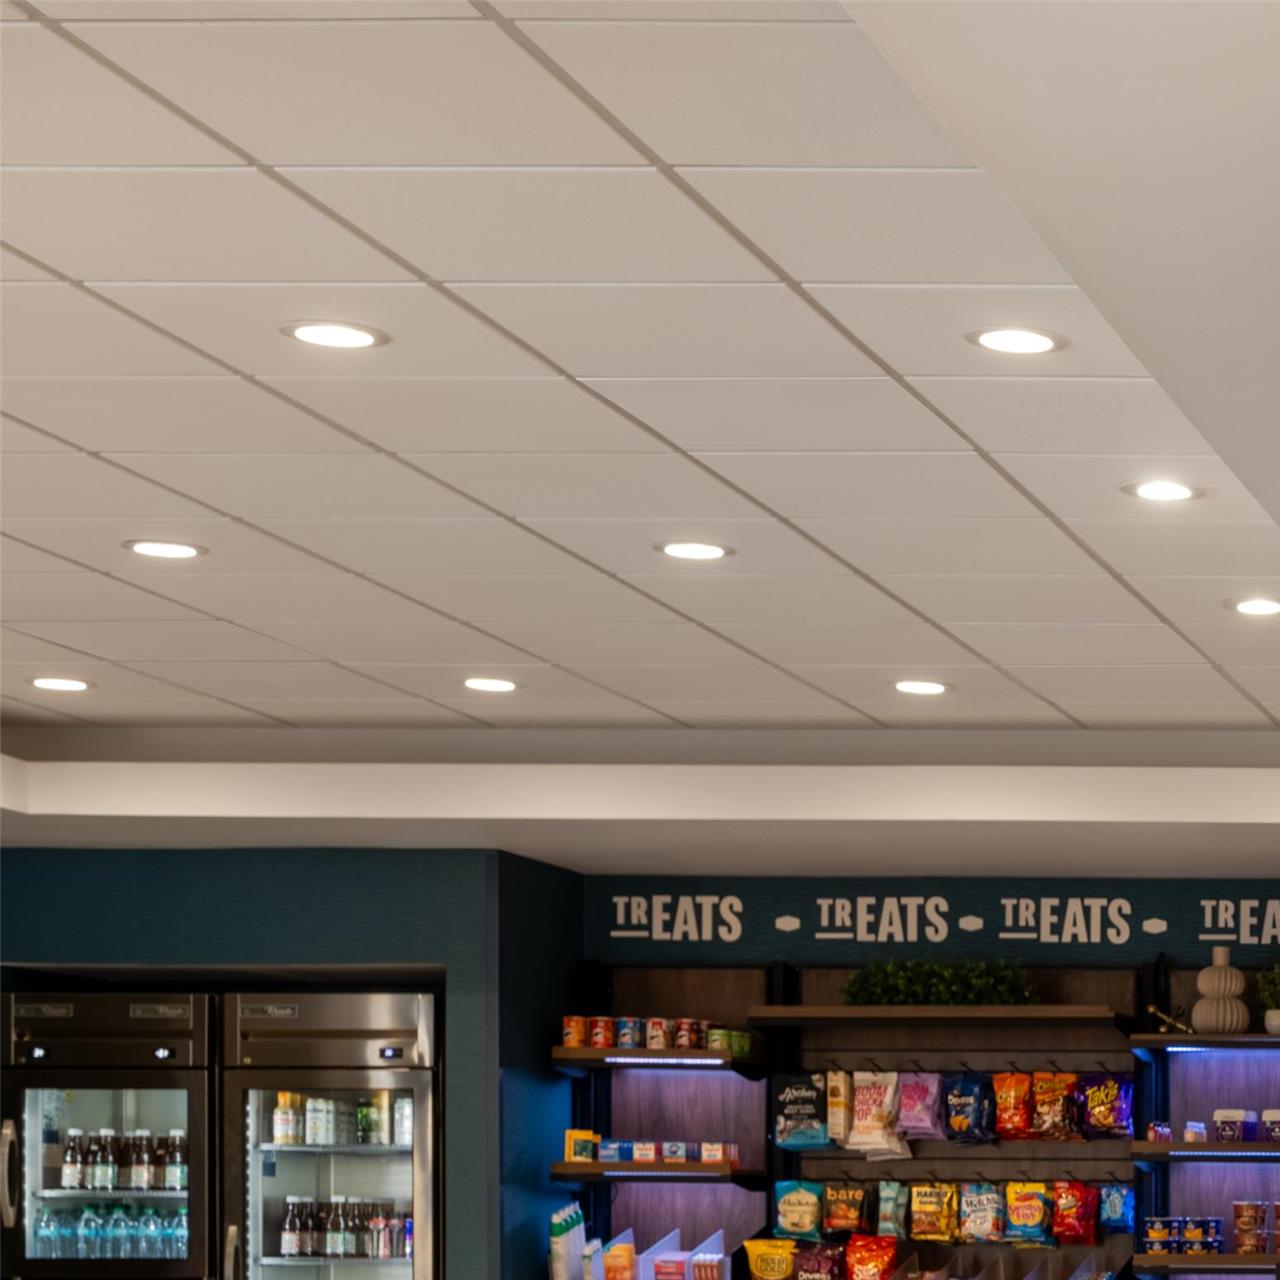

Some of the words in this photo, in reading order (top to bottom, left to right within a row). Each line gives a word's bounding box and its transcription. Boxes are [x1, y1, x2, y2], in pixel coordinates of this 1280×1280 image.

[611, 895, 744, 942] TREATS
[815, 896, 950, 943] TREATS
[999, 897, 1132, 944] TREATS
[826, 1187, 864, 1201] bare
